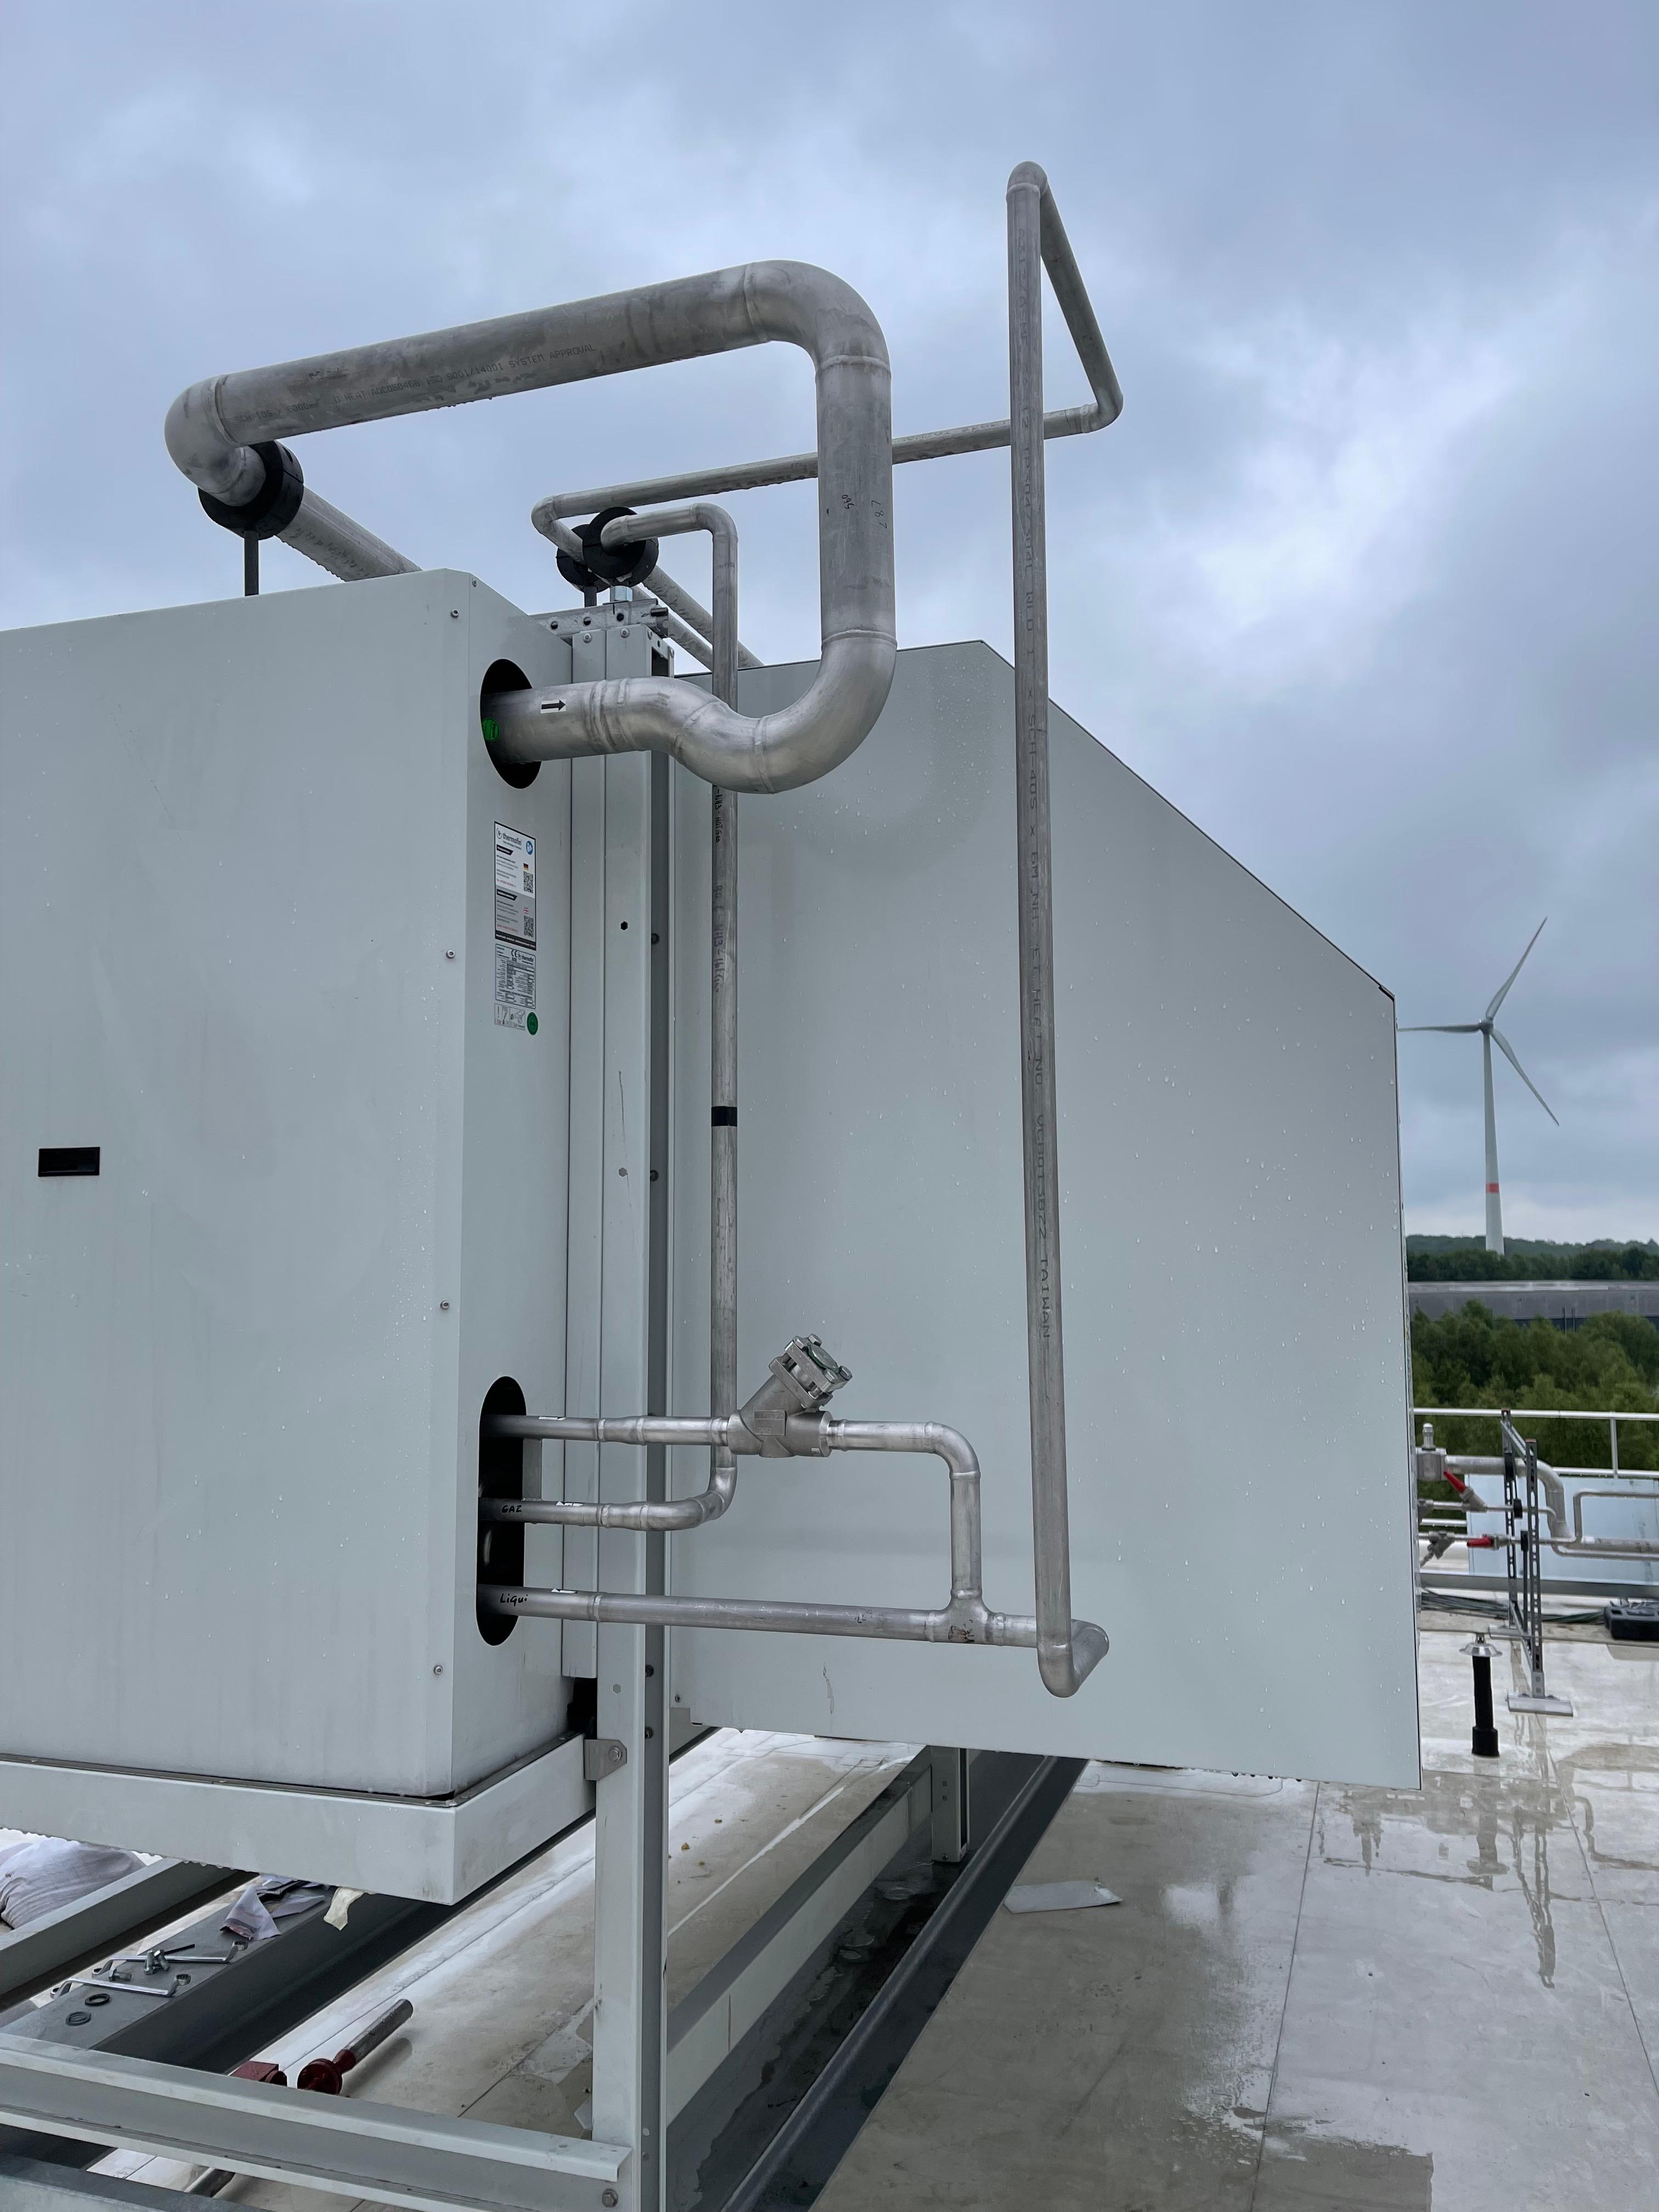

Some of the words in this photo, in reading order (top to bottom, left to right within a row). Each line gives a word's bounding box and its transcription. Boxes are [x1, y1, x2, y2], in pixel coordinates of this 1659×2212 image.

[447, 362, 504, 380] 9001/14001
[509, 354, 545, 368] SYSTEM
[549, 343, 597, 359] APPROVAL
[1041, 1255, 1051, 1338] TAIWAN
